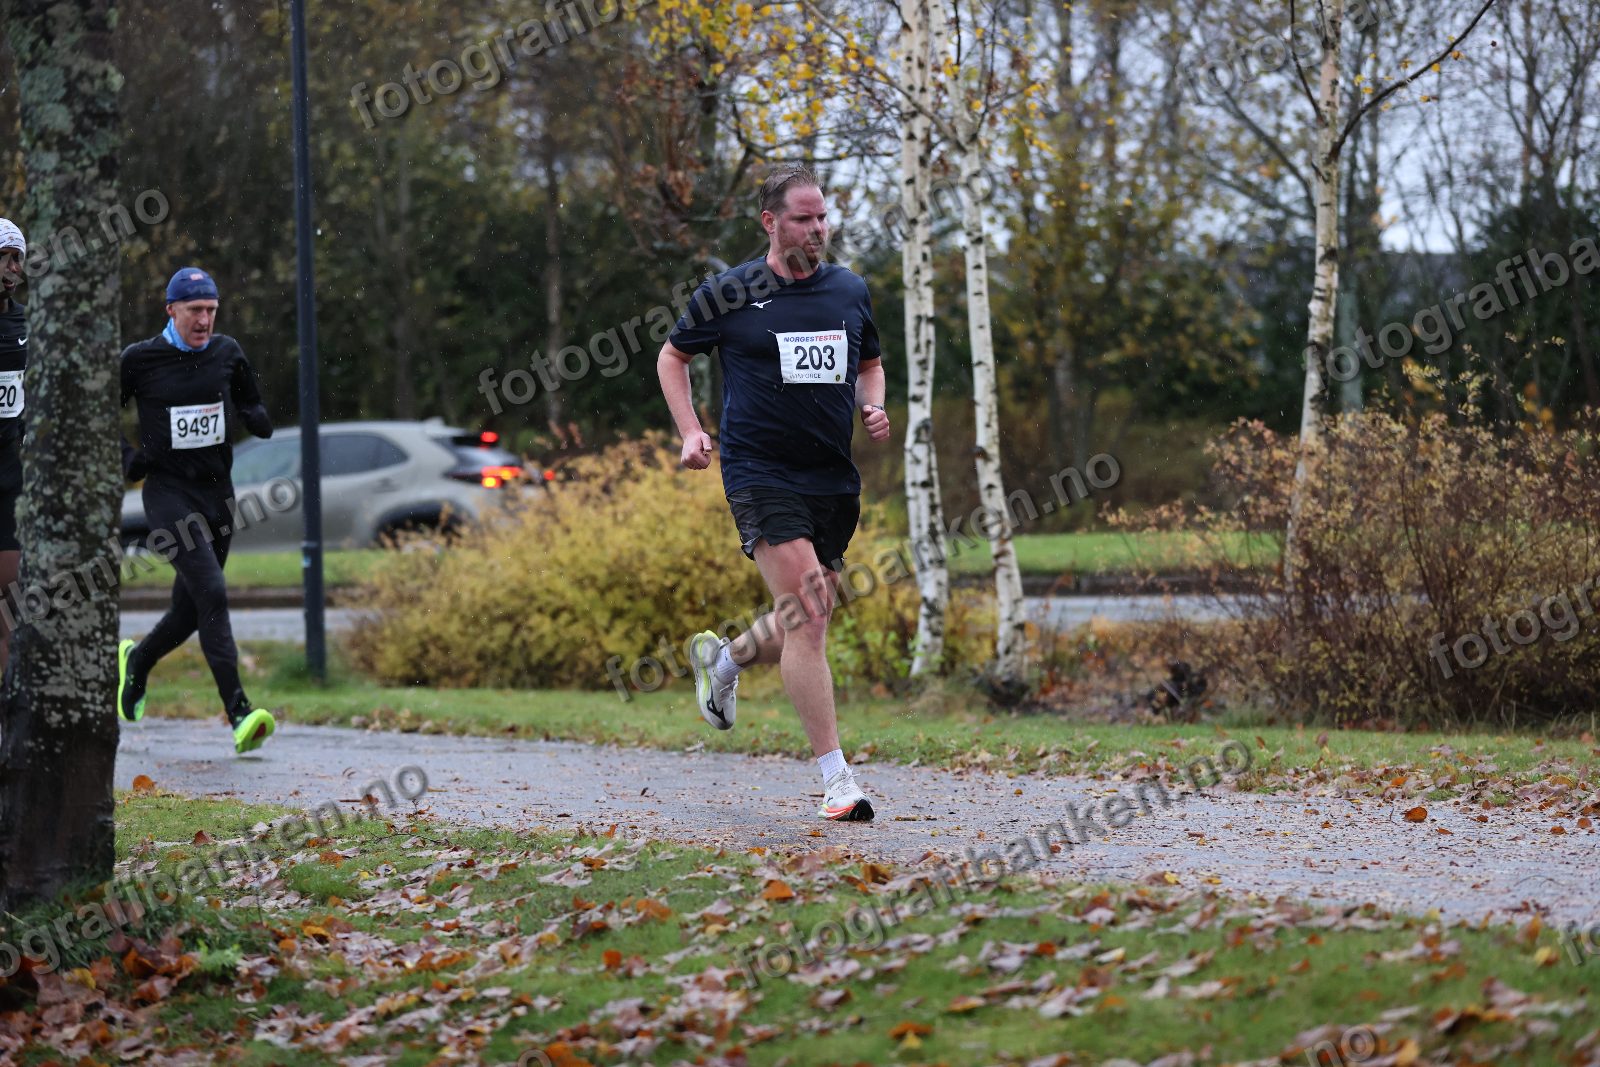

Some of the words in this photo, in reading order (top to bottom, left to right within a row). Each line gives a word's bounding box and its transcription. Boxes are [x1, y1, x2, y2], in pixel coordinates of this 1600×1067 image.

[783, 334, 842, 342] NORGESTESTEN
[794, 345, 836, 370] 203
[176, 414, 219, 438] 9497
